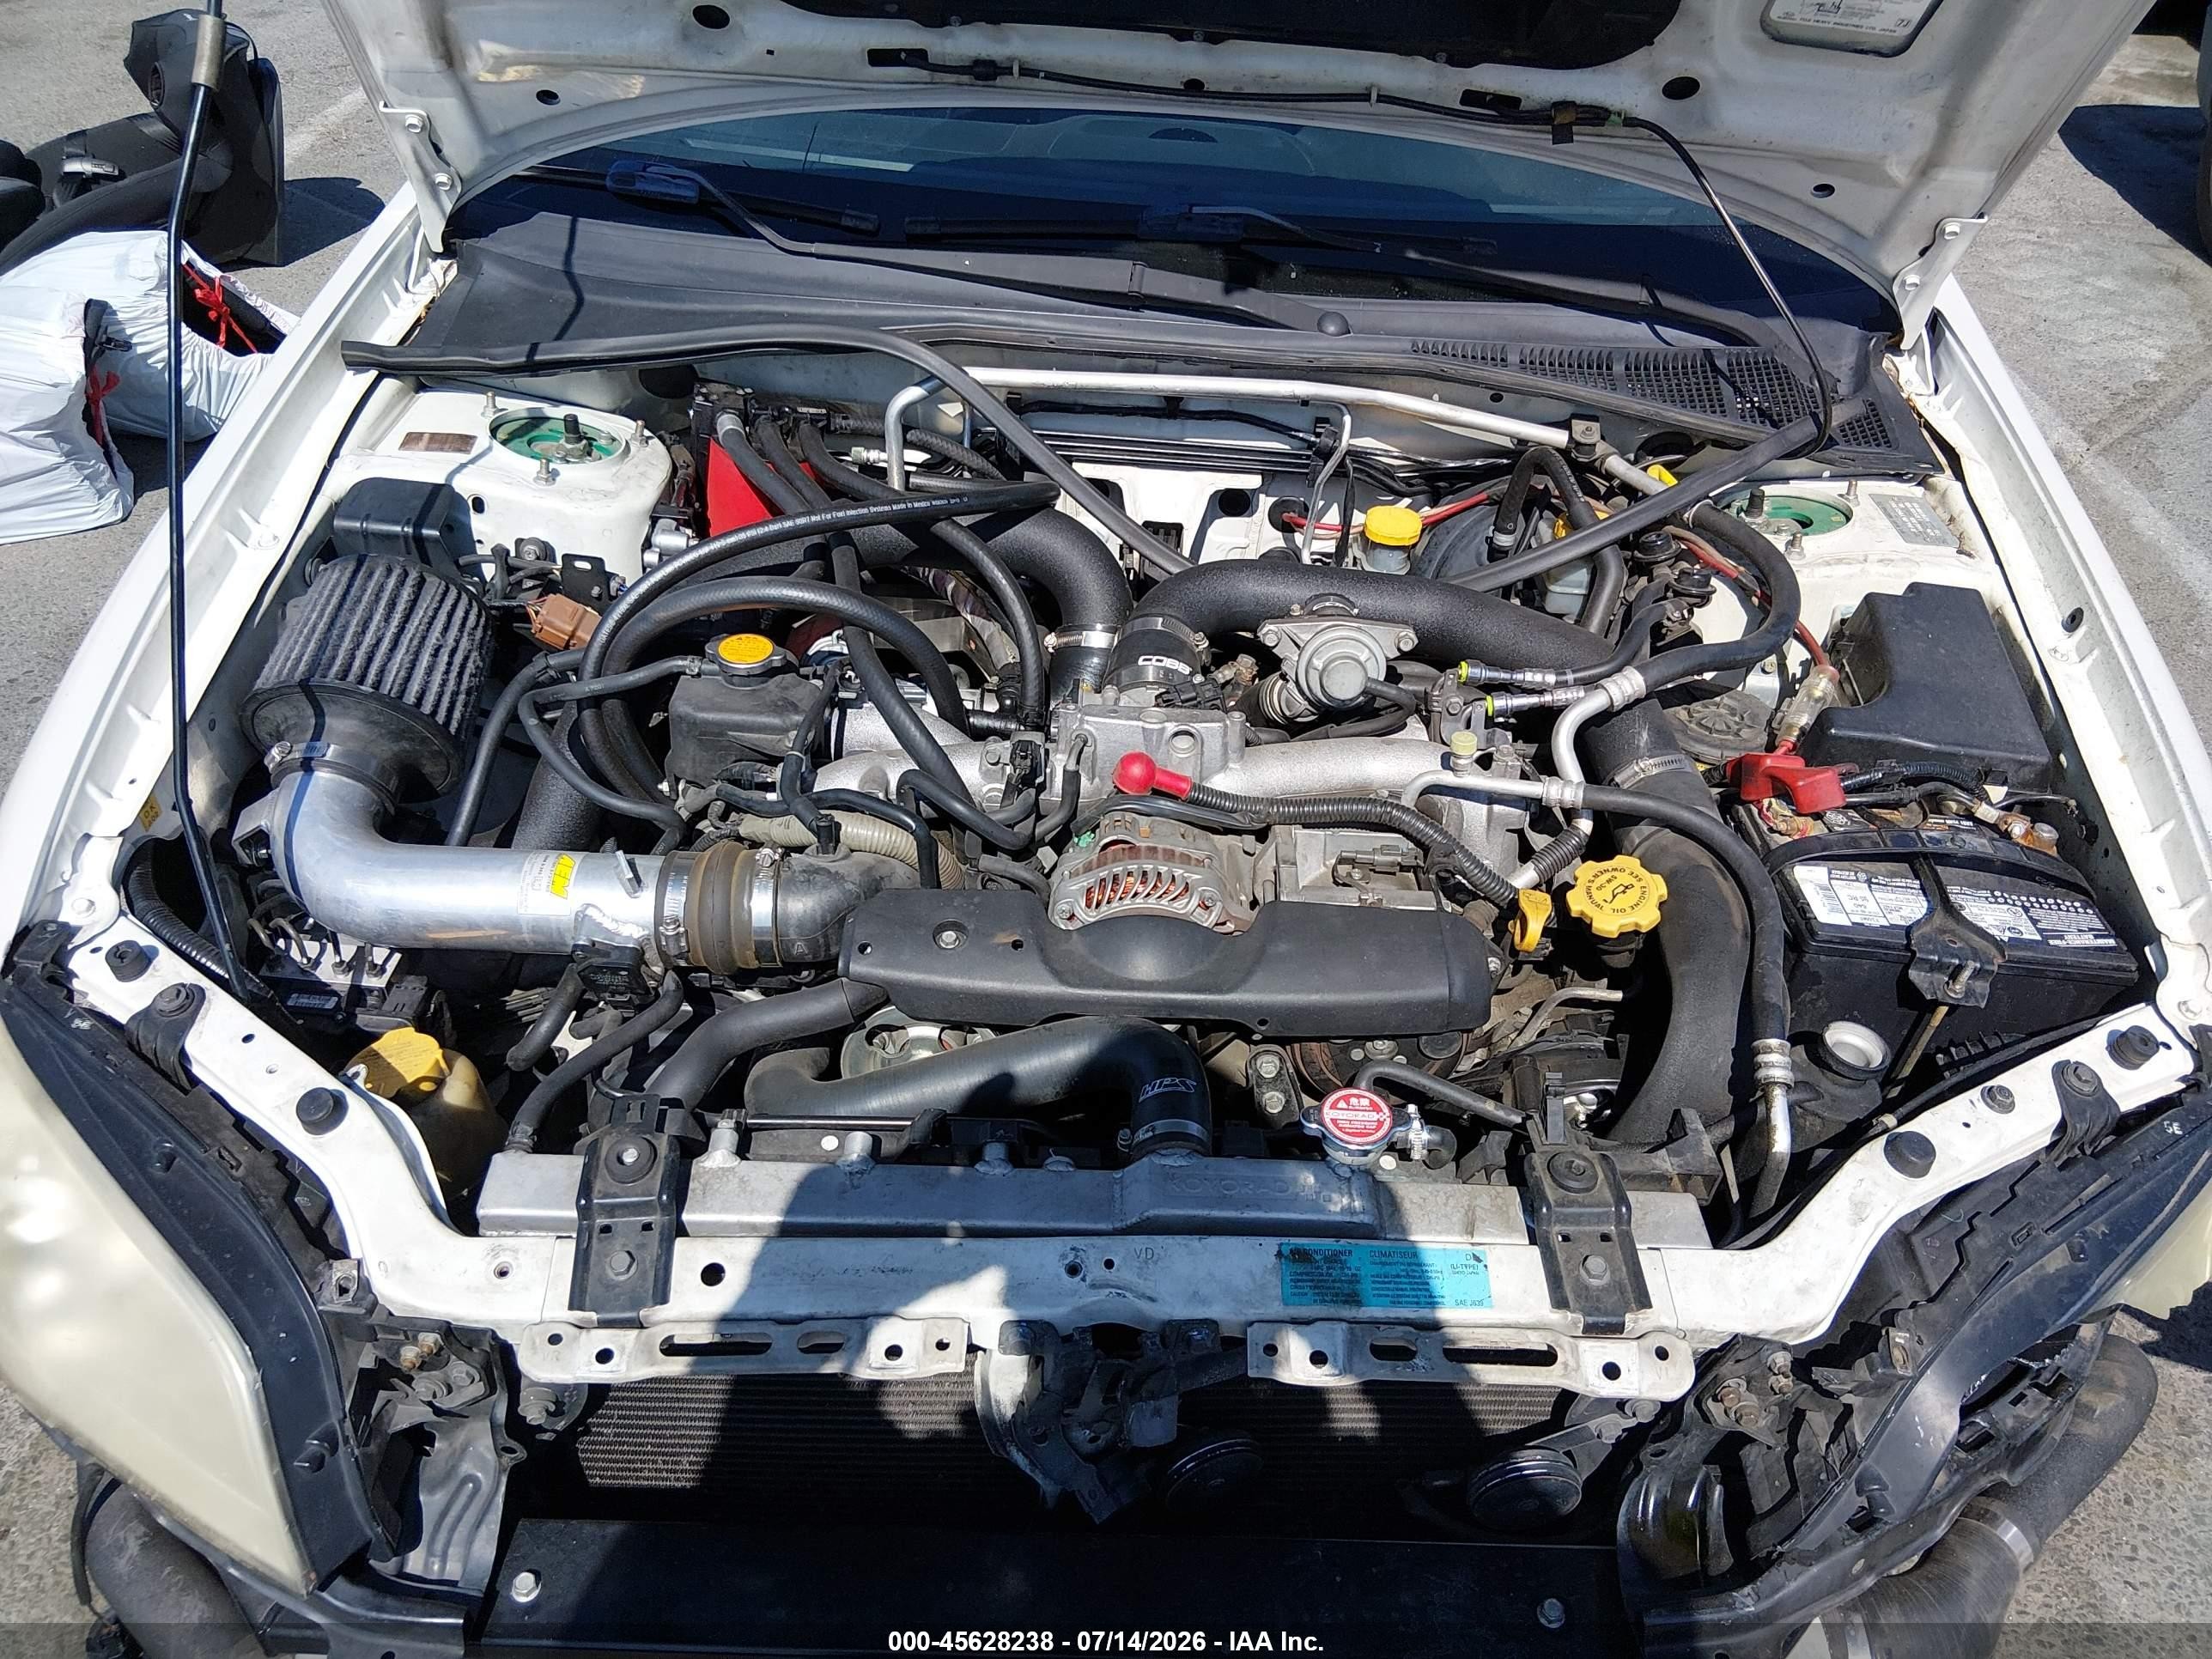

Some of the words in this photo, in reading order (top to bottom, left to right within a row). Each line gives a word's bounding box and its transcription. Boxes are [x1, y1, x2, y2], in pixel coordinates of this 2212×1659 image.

[832, 509, 846, 518] Fuel
[892, 501, 907, 511] Made
[913, 500, 931, 508] Mexico
[1138, 655, 1190, 675] COBB
[1596, 874, 1618, 891] 5W-30
[1627, 870, 1644, 883] SEE
[1585, 885, 1604, 910] MANUAL
[1628, 885, 1647, 911] ENGINE
[1139, 1077, 1197, 1103] HPS
[1134, 1247, 1154, 1260] VD
[1370, 1249, 1419, 1259] CLIMATISEUR
